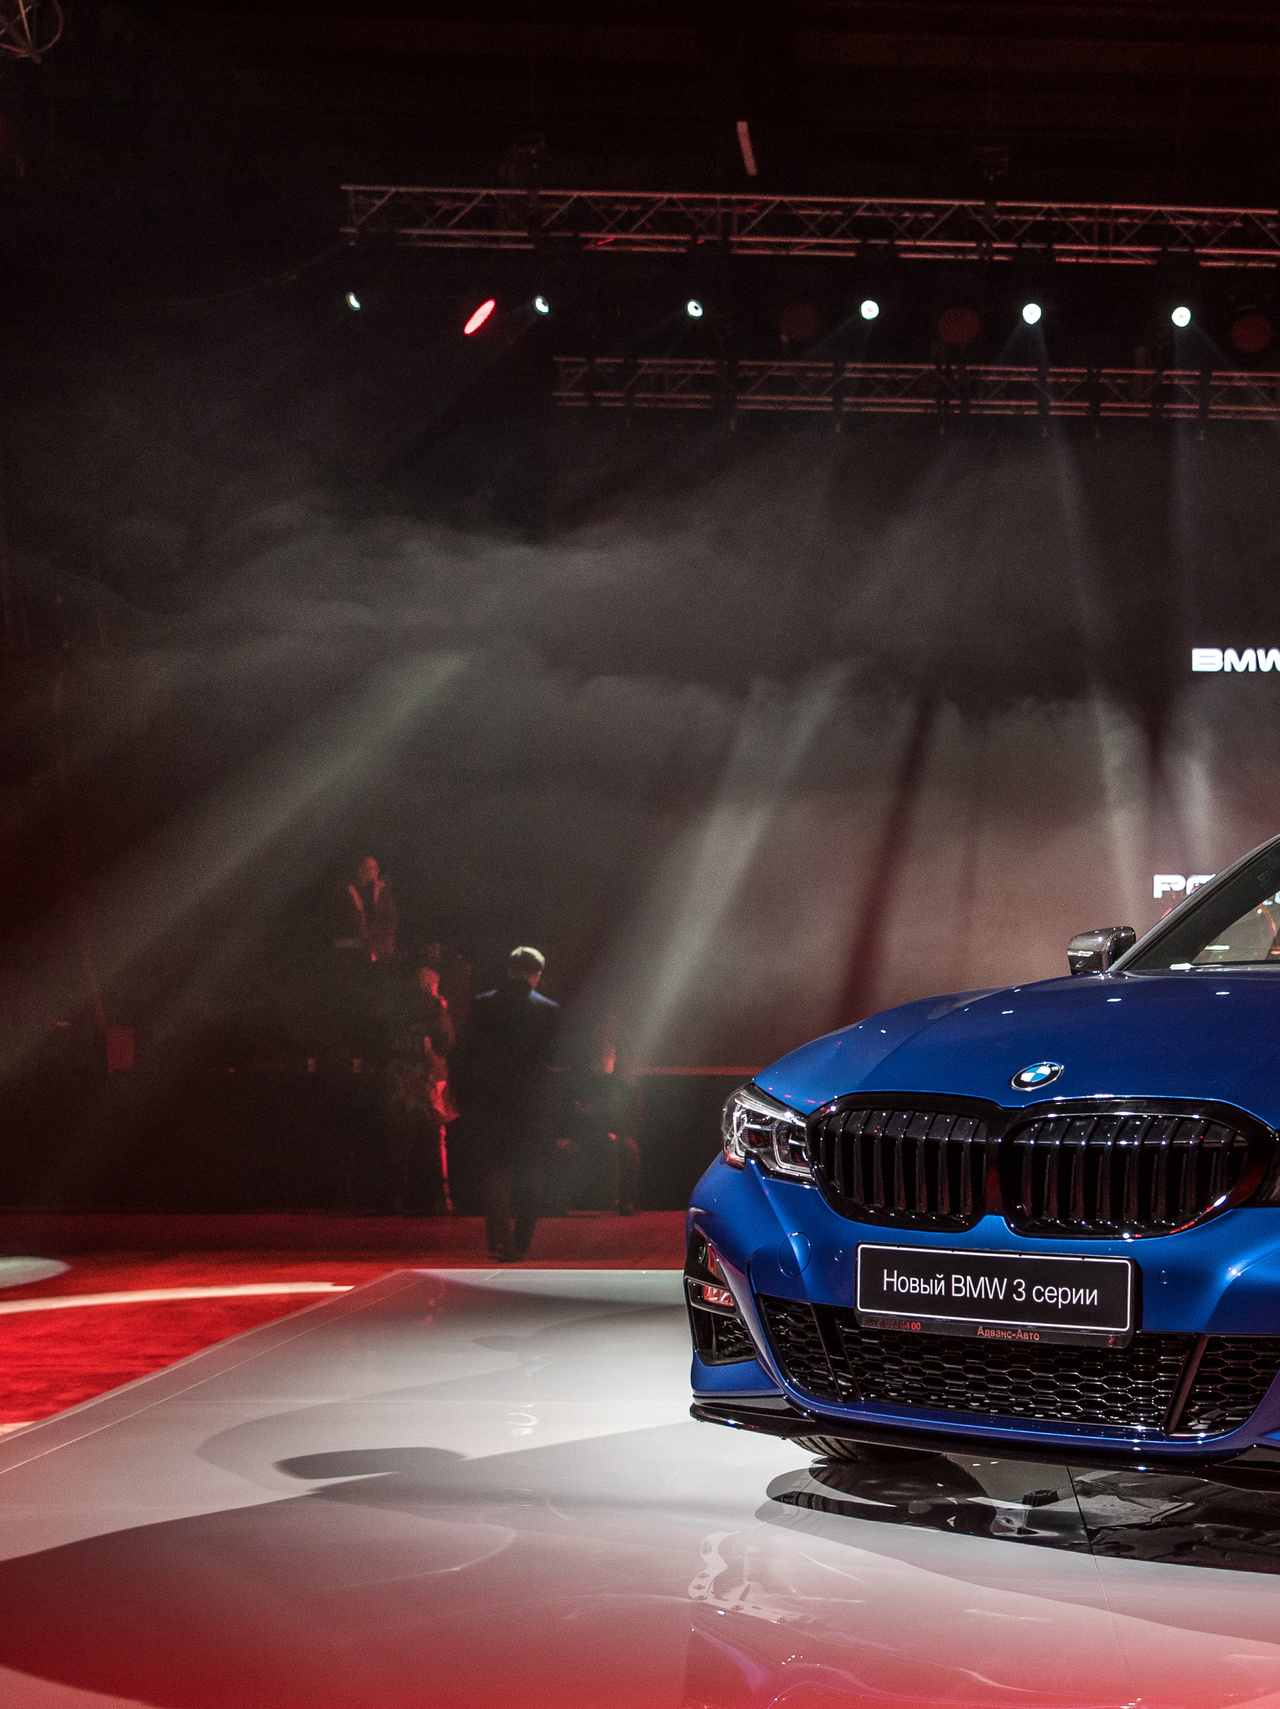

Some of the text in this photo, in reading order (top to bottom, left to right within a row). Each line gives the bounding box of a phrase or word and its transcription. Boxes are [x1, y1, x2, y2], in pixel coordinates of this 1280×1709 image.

[883, 1269, 1098, 1309] Новый BMW 3 серии
[976, 1325, 1040, 1341] Адванс-Авто
